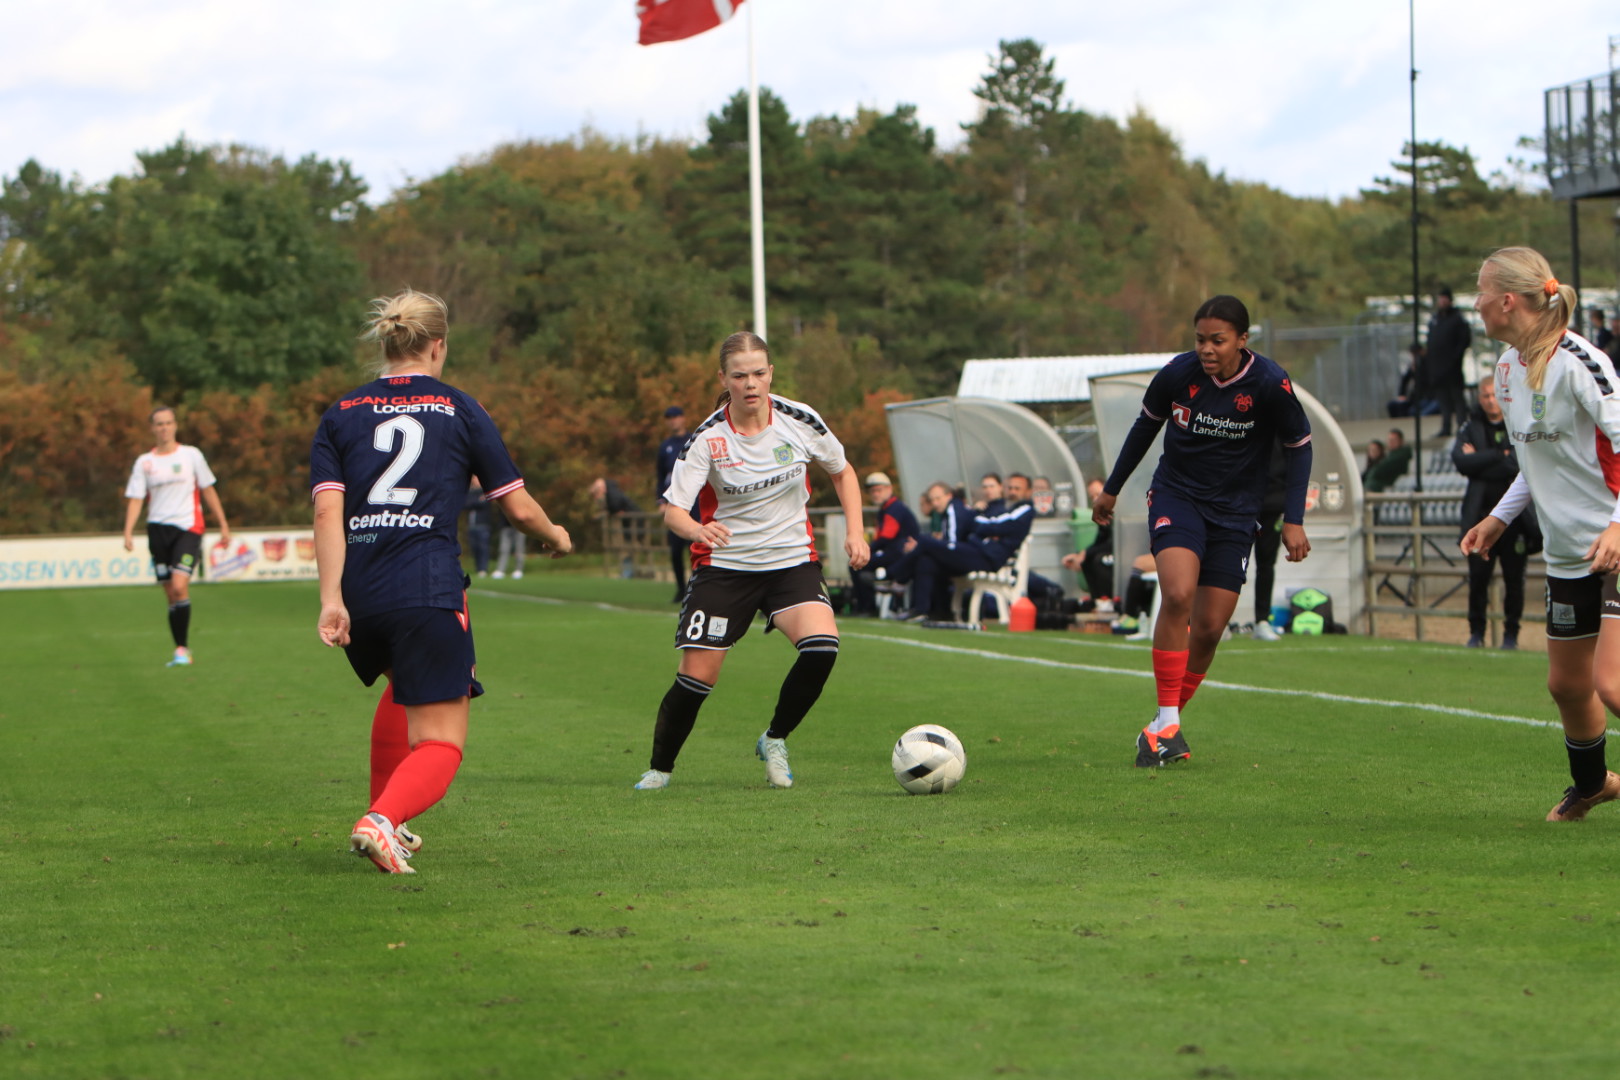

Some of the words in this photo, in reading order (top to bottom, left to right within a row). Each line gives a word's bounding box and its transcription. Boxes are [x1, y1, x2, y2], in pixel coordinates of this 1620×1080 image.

[339, 395, 388, 410] SCAN
[390, 395, 455, 408] GLOBAL
[373, 402, 455, 417] LOGISTICS
[1195, 412, 1255, 430] Arbejdernes
[1192, 423, 1247, 440] Landsbank
[367, 414, 426, 507] 2
[722, 464, 803, 496] SKECHERS
[348, 508, 435, 531] centrica
[347, 532, 378, 545] Energy
[107, 556, 141, 579] OG
[686, 609, 706, 641] 8
